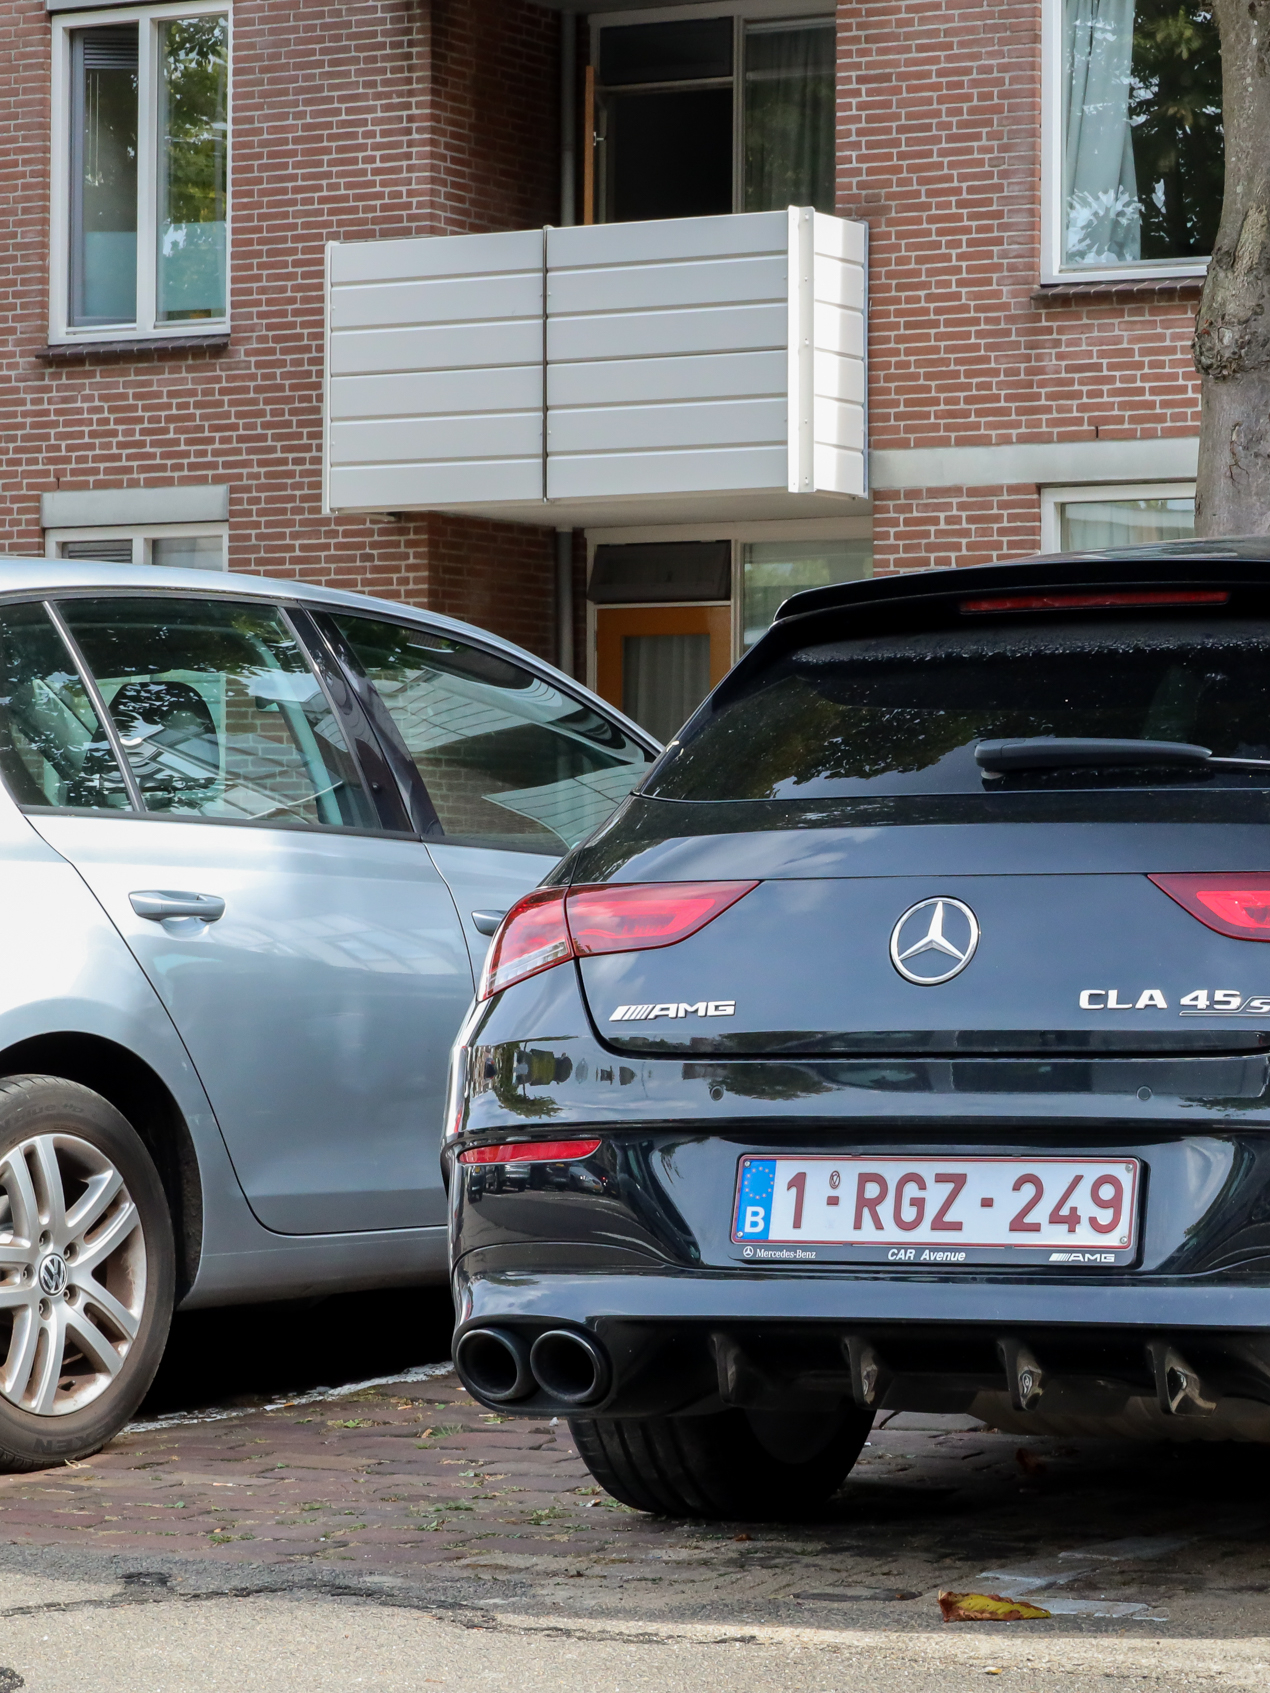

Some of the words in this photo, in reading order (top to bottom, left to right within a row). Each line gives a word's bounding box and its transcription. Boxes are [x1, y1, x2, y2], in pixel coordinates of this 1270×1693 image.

[1079, 989, 1168, 1010] CLA
[652, 1000, 736, 1018] AMG
[786, 1171, 1124, 1234] 1-RGZ-249
[743, 1206, 766, 1233] B
[755, 1248, 816, 1259] Mercedes-Benz
[887, 1249, 919, 1260] CAR
[922, 1249, 967, 1261] Avenue
[1069, 1252, 1115, 1262] AMG
